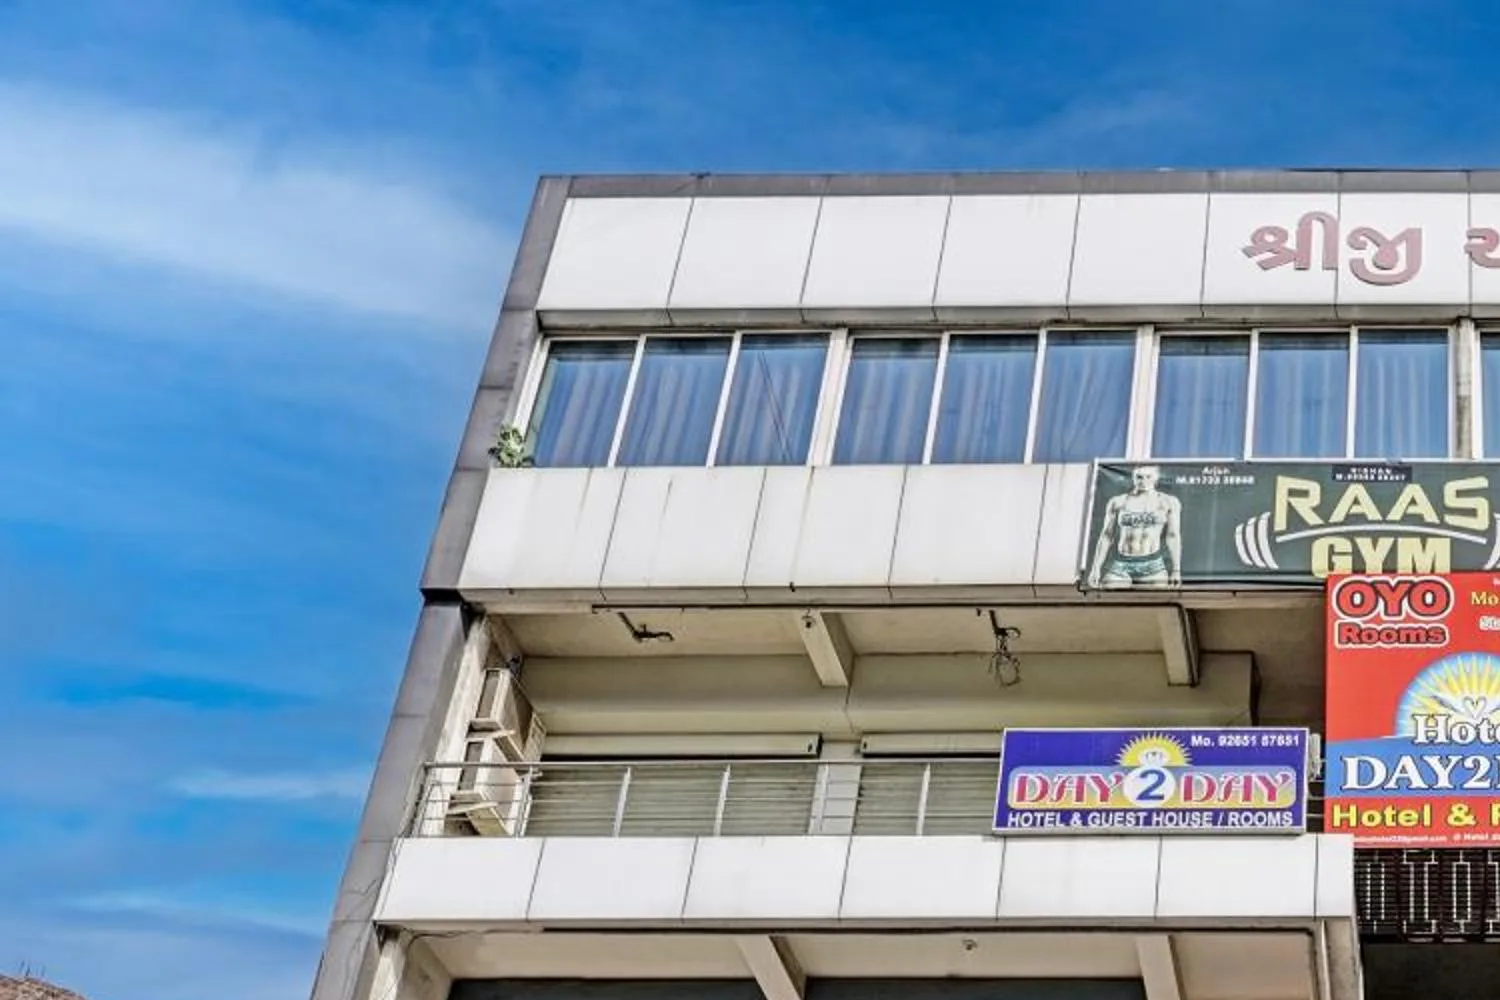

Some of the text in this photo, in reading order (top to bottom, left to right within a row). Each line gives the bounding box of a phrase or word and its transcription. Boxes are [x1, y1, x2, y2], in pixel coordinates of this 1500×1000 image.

[1240, 210, 1424, 286] શ્રીજી
[1274, 474, 1490, 532] RAAS
[1311, 536, 1451, 577] GYM
[1333, 577, 1454, 620] OYO
[1336, 621, 1449, 647] Rooms
[1191, 734, 1215, 747] Mo.
[1012, 768, 1292, 805] DAY 2 DAY
[1007, 810, 1294, 828] HOTEL & GUEST HOUSE / ROOMS
[1332, 803, 1431, 828] Hotel
[1446, 803, 1478, 827] &
